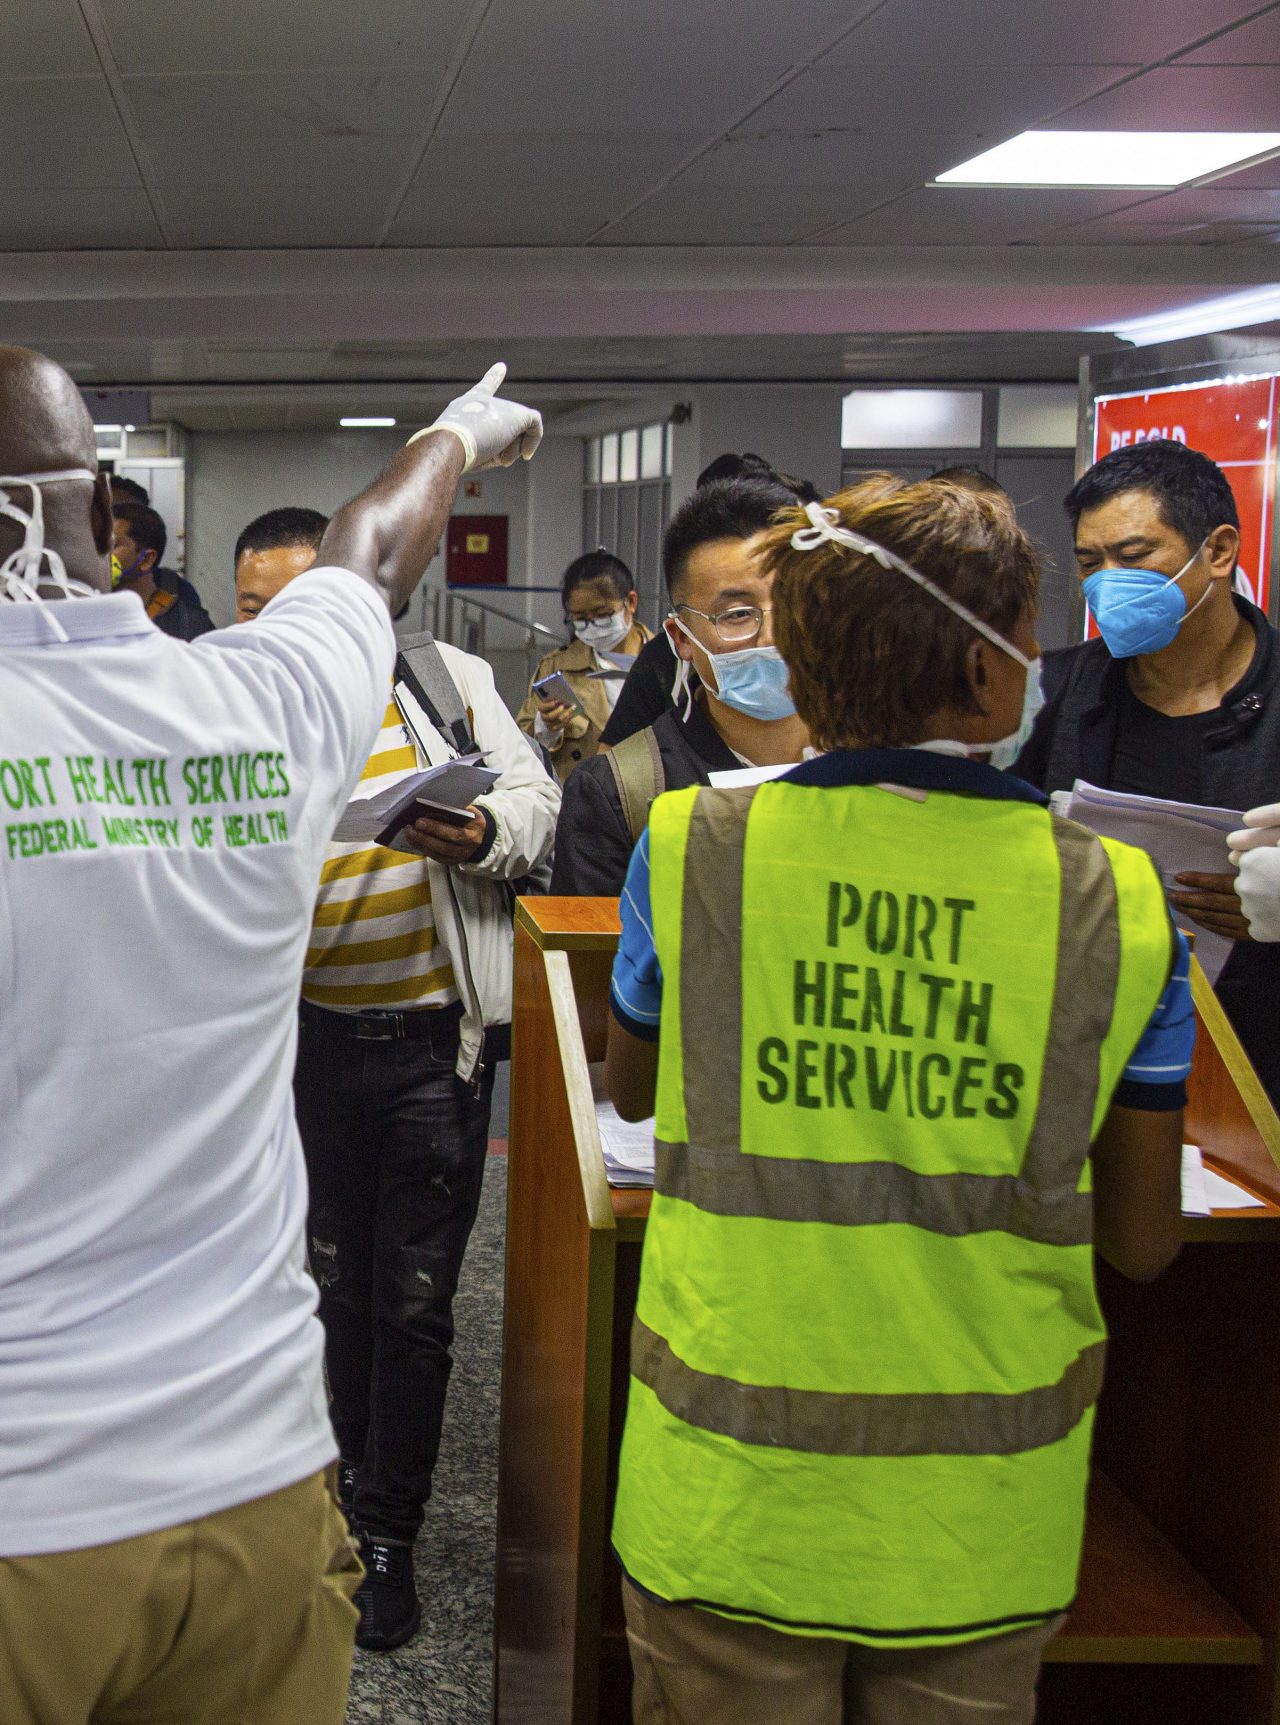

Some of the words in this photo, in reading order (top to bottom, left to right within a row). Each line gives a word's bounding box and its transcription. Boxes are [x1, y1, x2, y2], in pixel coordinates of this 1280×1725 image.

[65, 756, 172, 806] HEALTH
[182, 751, 290, 805] SERVICES
[5, 817, 98, 859] FEDERAL
[102, 815, 181, 848] MINISTRY
[191, 815, 214, 848] OF
[222, 810, 288, 848] HEALTH
[826, 881, 976, 965] PORT
[792, 959, 994, 1047] HEALTH
[756, 1036, 1025, 1120] SERVICES
